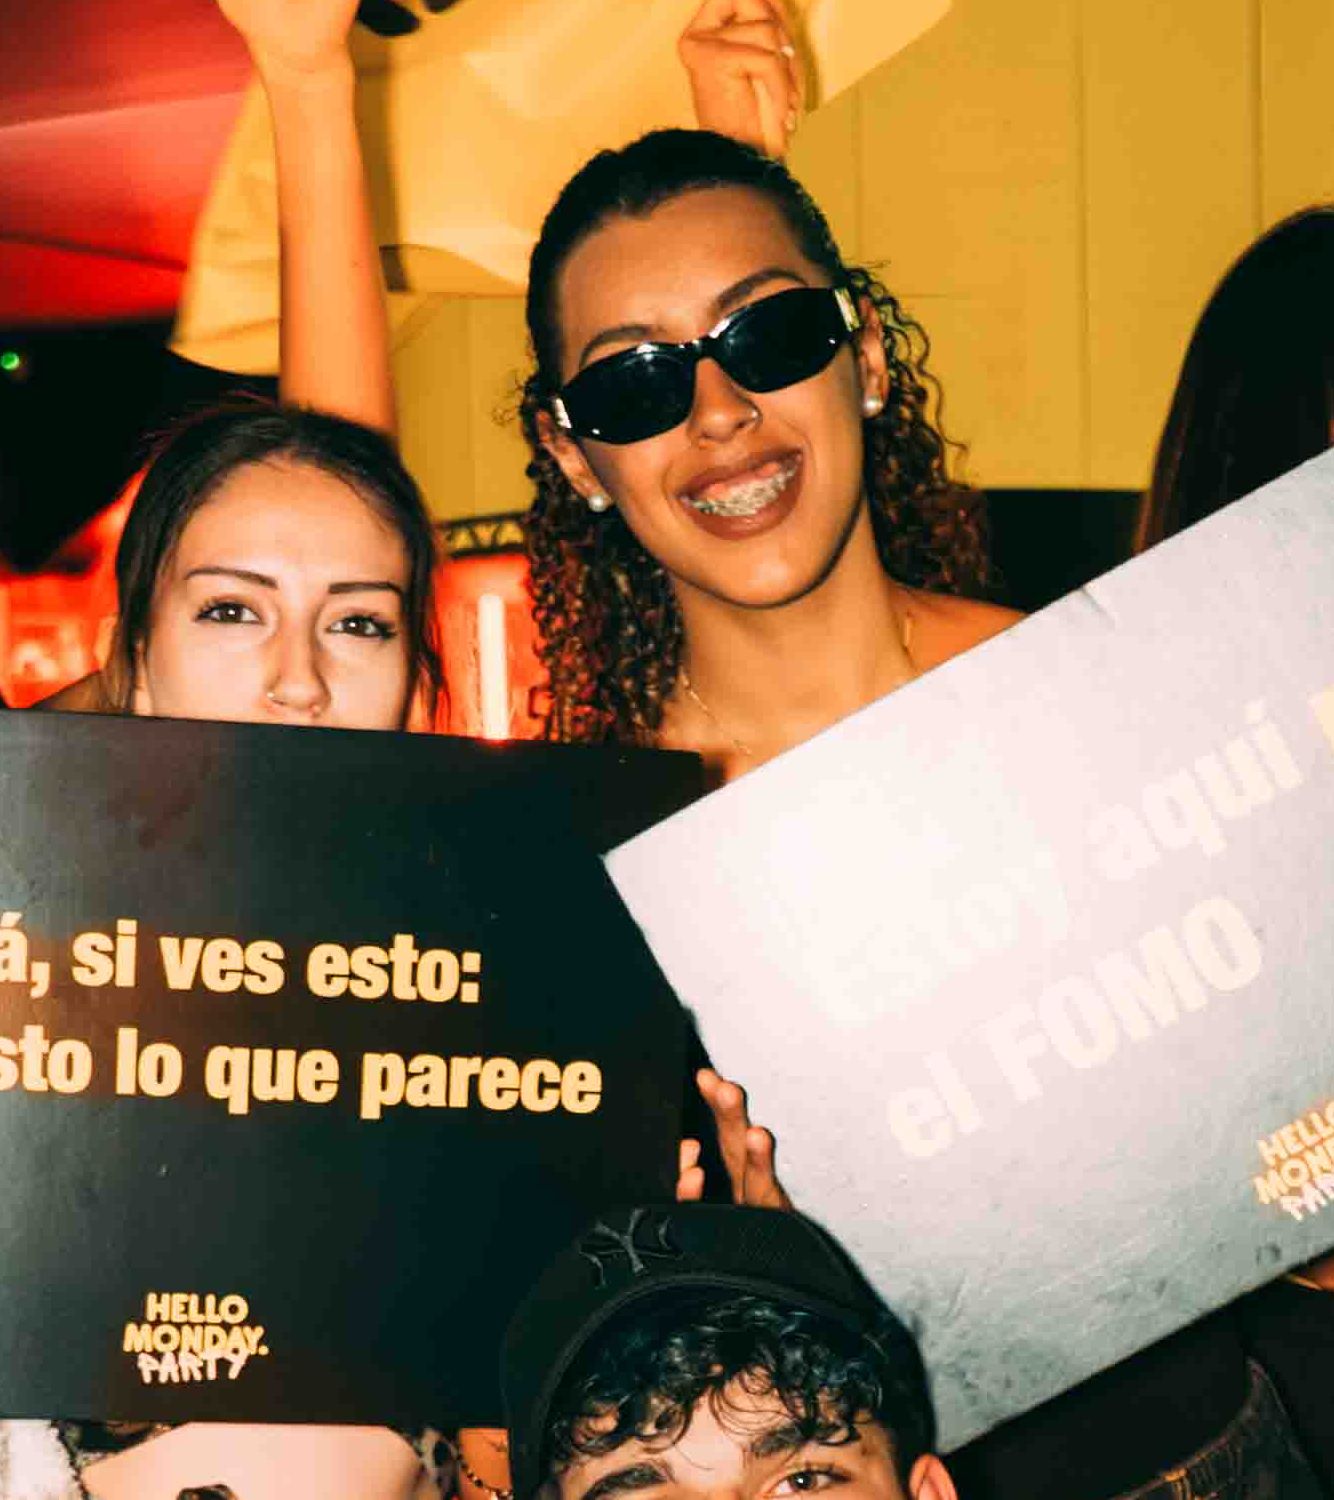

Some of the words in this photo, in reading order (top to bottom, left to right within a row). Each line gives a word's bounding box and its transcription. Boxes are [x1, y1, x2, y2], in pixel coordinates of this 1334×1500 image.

[72, 918, 138, 987] si
[160, 935, 285, 994] ves
[307, 933, 482, 1003] esto:
[887, 1052, 987, 1158] el
[978, 894, 1262, 1102] FOMO
[114, 1026, 184, 1098] lo
[204, 1045, 341, 1116] que
[359, 1052, 604, 1121] parece
[122, 1321, 270, 1356] MONDAY.
[146, 1291, 250, 1325] HELLO
[137, 1347, 251, 1385] PARTY
